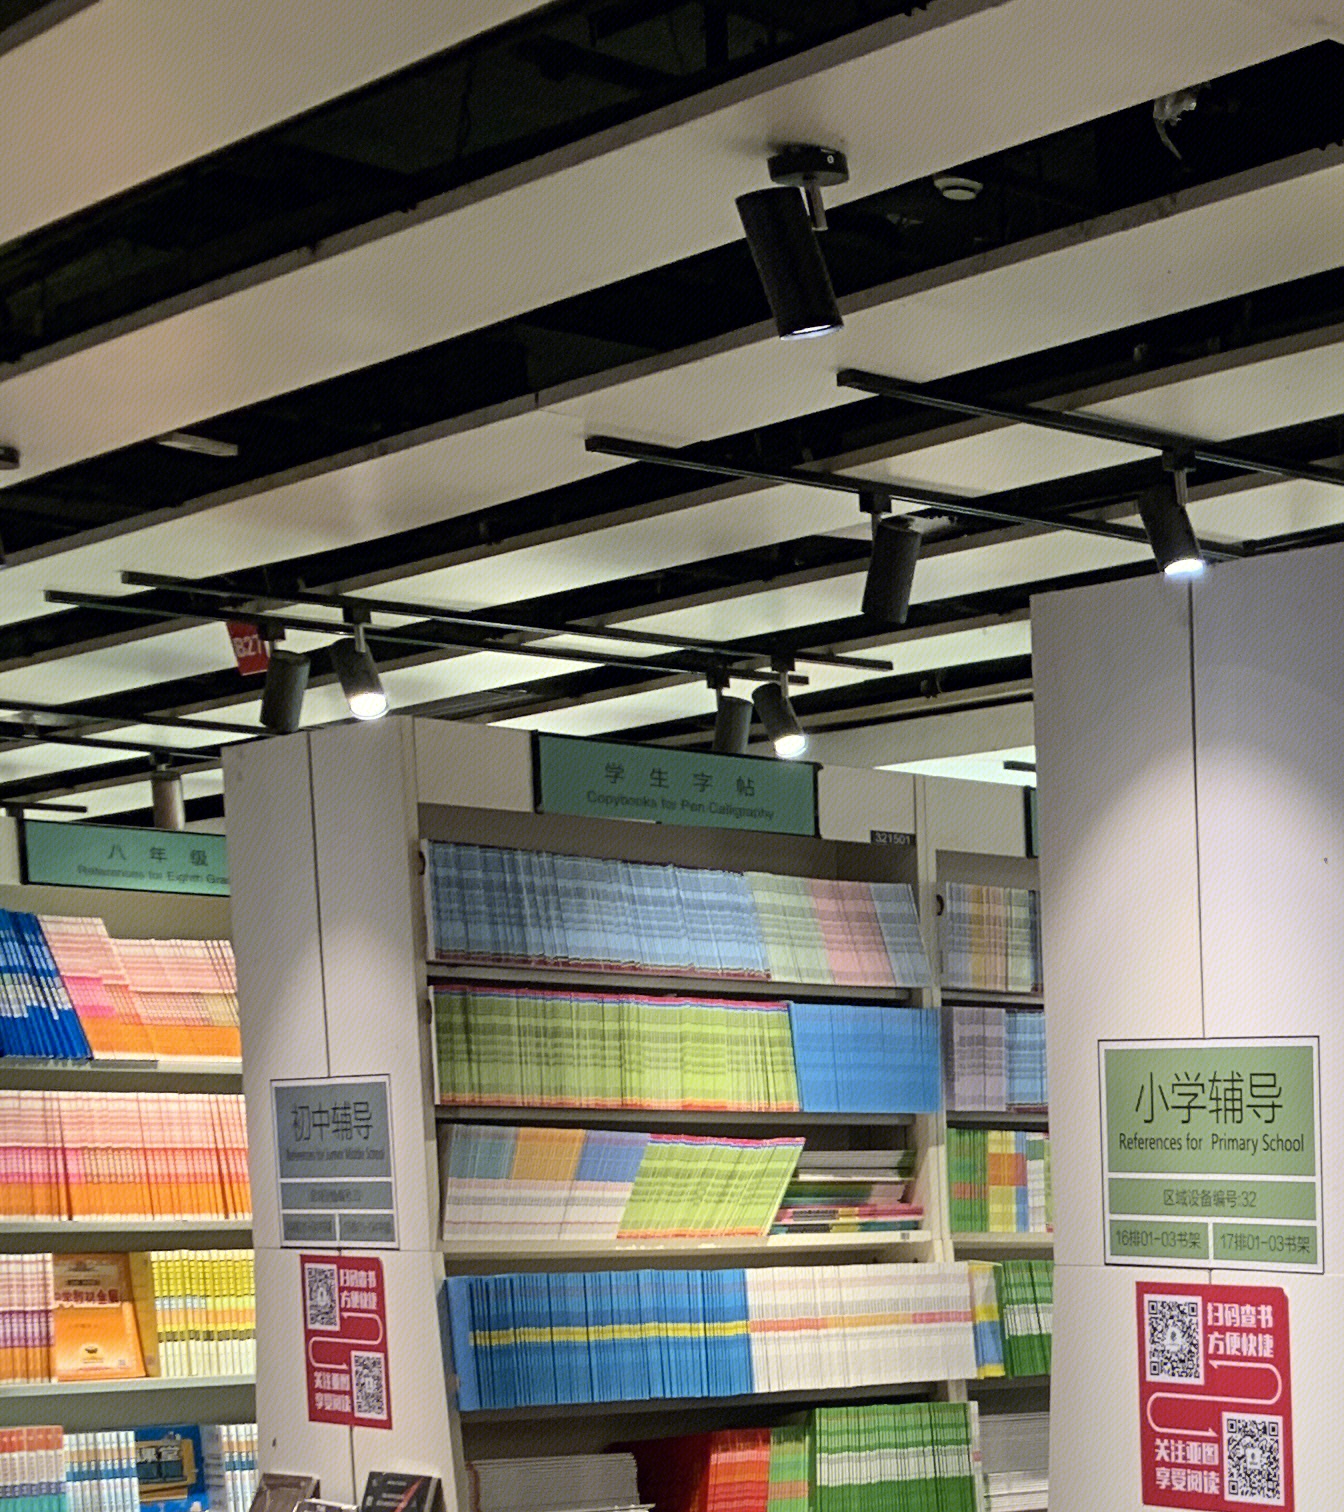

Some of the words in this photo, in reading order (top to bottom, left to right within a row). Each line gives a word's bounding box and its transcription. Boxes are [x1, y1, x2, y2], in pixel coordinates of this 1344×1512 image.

[605, 762, 755, 797] 学生字帖
[587, 790, 657, 811] Copybooks
[662, 798, 676, 810] for
[681, 799, 705, 812] Pen
[709, 802, 774, 820] Calligraphy
[108, 845, 208, 866] 八年级
[1135, 1071, 1284, 1124] 小学辅导
[291, 1101, 373, 1142] 初中辅导
[1119, 1133, 1182, 1151] References
[1186, 1133, 1203, 1151] for
[1212, 1134, 1259, 1156] Primary
[1262, 1134, 1304, 1153] School
[1207, 1302, 1273, 1329] 扫码查书
[1207, 1332, 1274, 1358] 方便快捷
[1154, 1438, 1219, 1466] 关注亚图
[1155, 1467, 1220, 1495] 享受阅读
